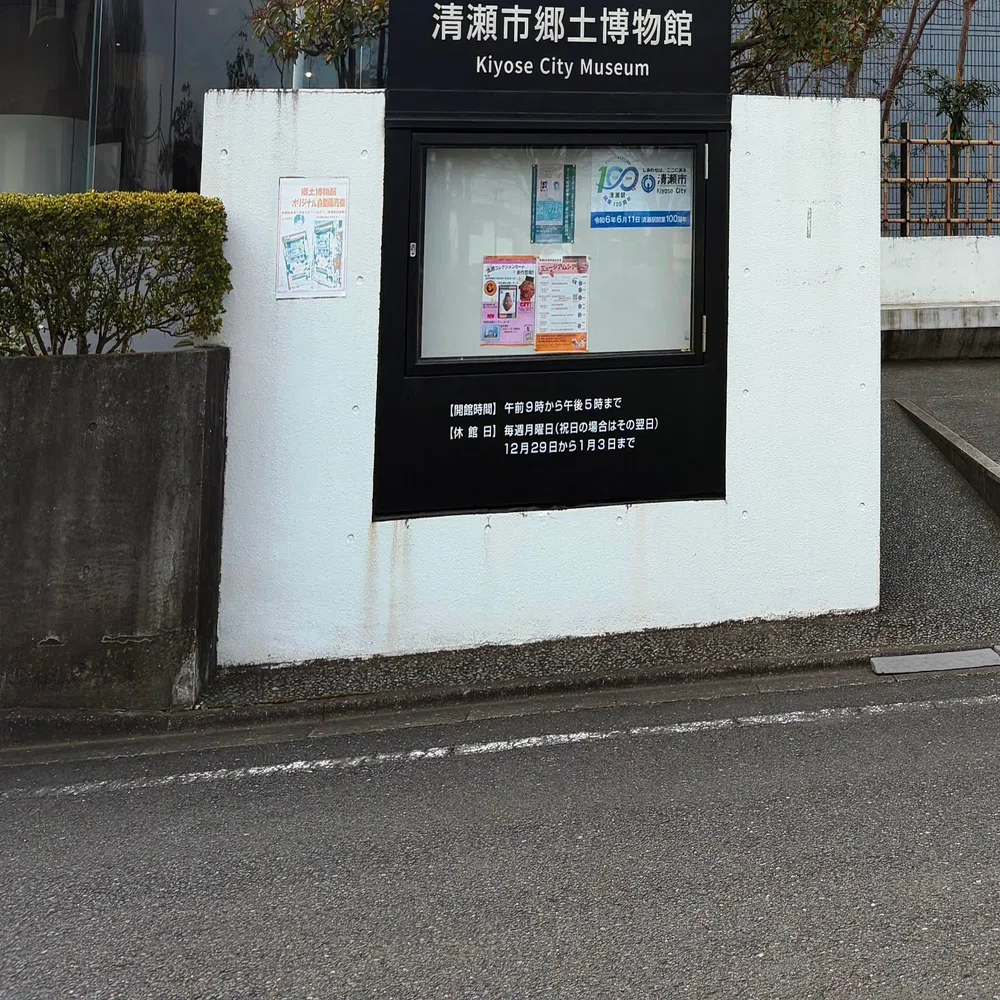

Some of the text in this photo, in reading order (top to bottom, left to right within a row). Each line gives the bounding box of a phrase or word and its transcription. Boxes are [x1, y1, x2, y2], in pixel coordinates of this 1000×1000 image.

[431, 2, 693, 47] 清瀬市郷土博物館
[476, 55, 649, 79] Kiyose City Museum
[657, 173, 687, 185] 清瀬市
[450, 397, 622, 417] 【開館時間】 午前9時から午後5時まで
[504, 417, 659, 437] 毎週月曜日（祝日の場合はその翌日）
[504, 437, 636, 455] 12月29日から1月3日まで
